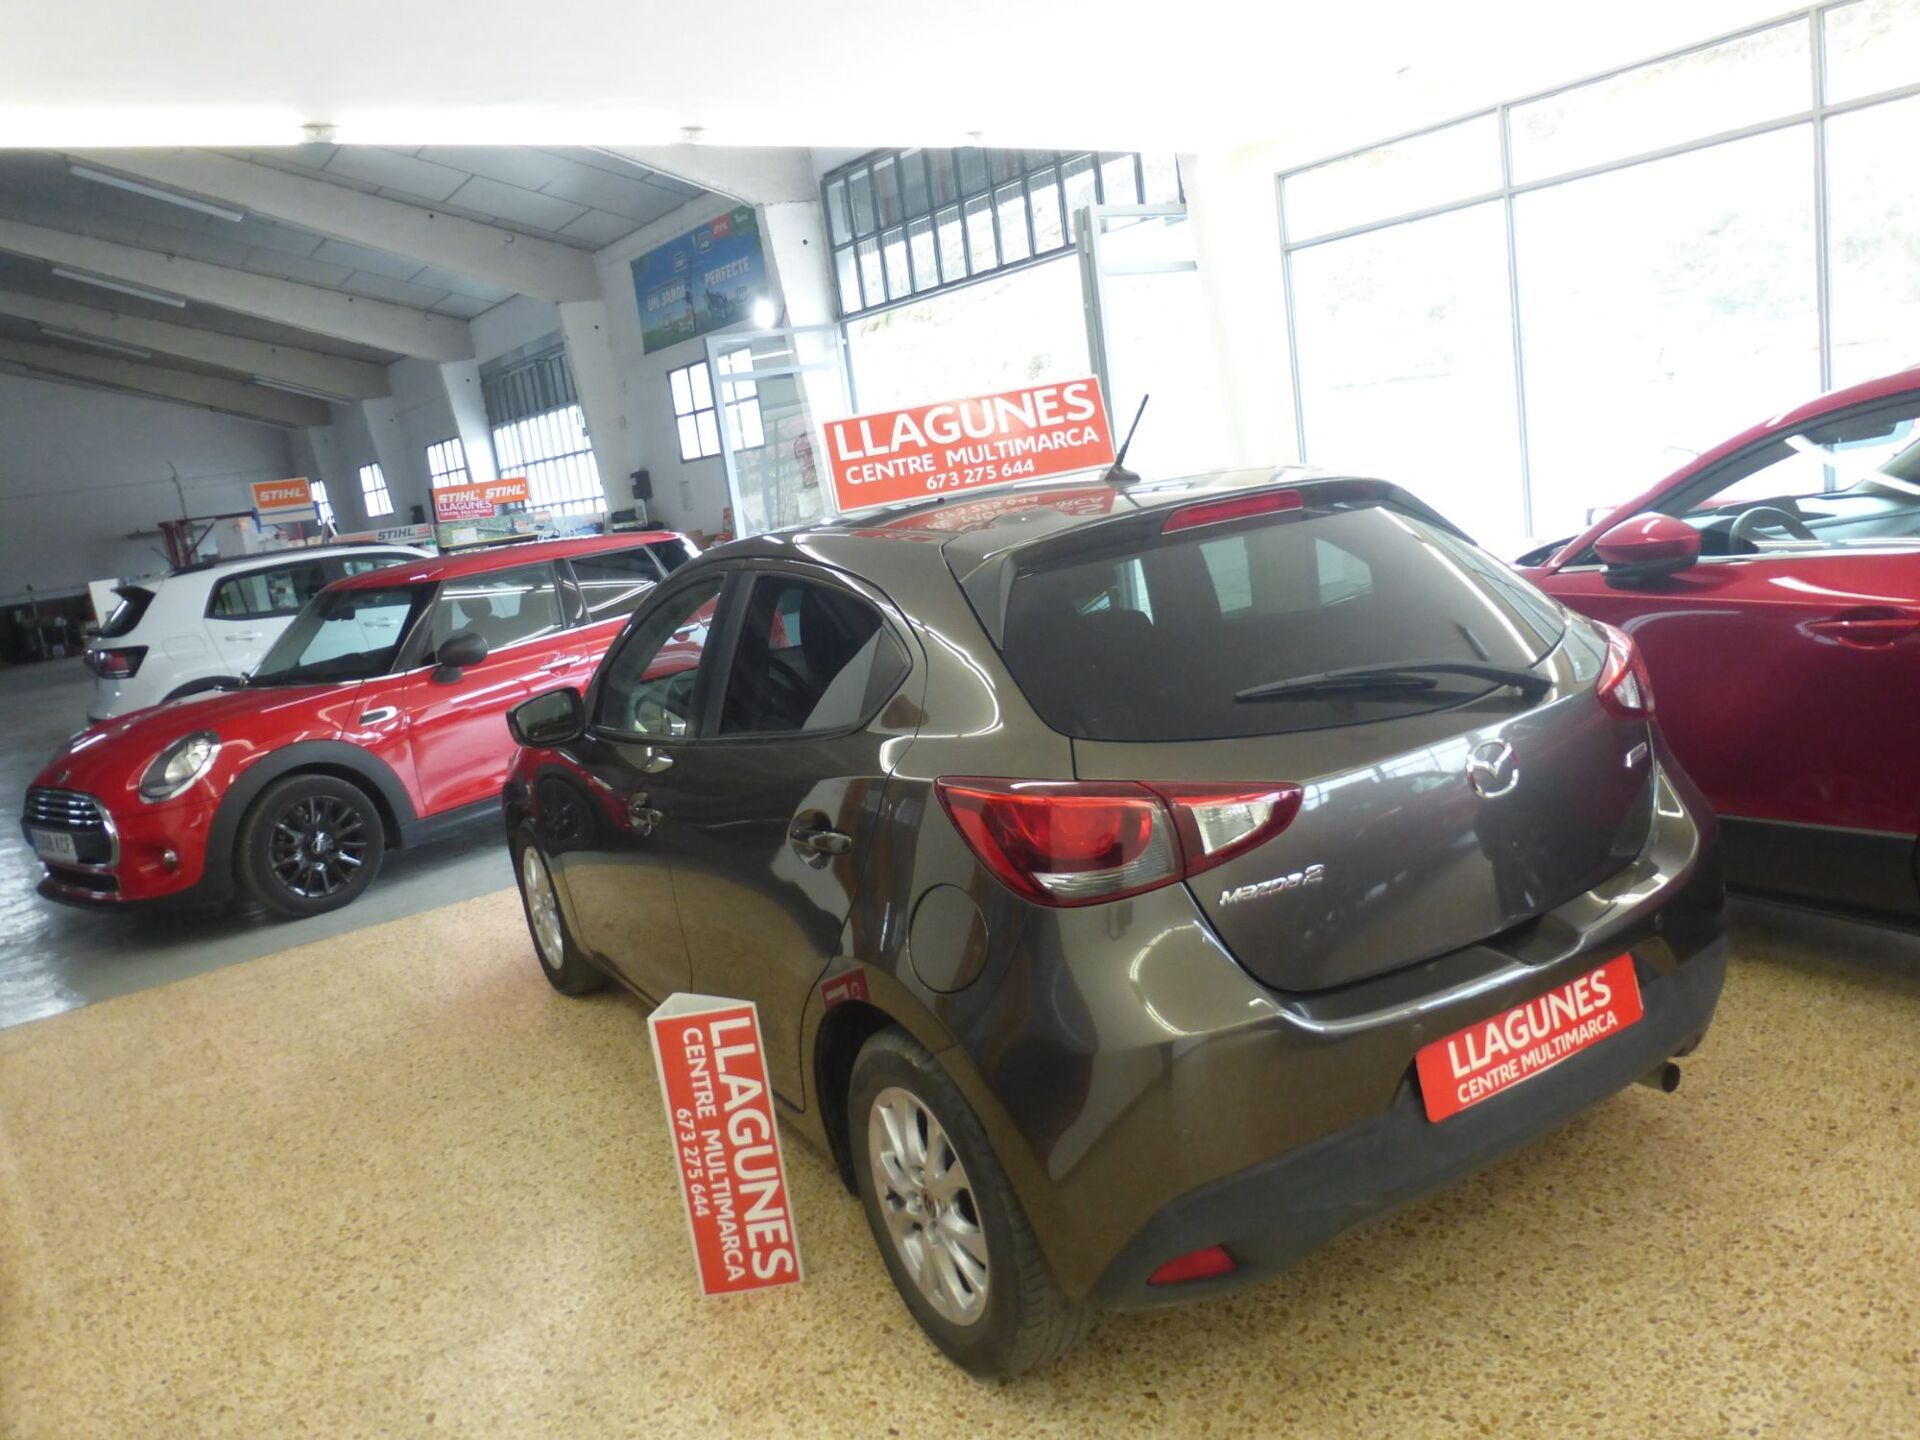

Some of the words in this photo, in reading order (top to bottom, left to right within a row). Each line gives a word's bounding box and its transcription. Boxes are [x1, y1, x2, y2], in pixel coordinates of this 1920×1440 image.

[705, 256, 750, 286] PERFECTE
[833, 382, 1095, 461] LLAGUNES
[845, 453, 936, 485] CENTRE
[945, 425, 1100, 468] MULTIMARCA
[926, 471, 960, 490] 673
[964, 464, 997, 485] 275
[1001, 457, 1035, 478] 644
[260, 487, 305, 501] STIHL
[438, 490, 479, 503] STIHL
[438, 500, 493, 512] LLAGUNES
[485, 485, 525, 499] STIHL
[378, 527, 415, 540] STIHL
[1447, 969, 1612, 1080] LLAGUNES
[1457, 1059, 1519, 1104] CENTRE
[1521, 1010, 1618, 1073] MULTIMARCA
[676, 1108, 697, 1141] 673
[682, 1027, 717, 1119] CENTRE
[700, 1128, 746, 1282] MULTIMARCA
[683, 1146, 704, 1179] 275
[709, 1016, 795, 1280] LLAGUNES
[690, 1185, 711, 1217] 644
